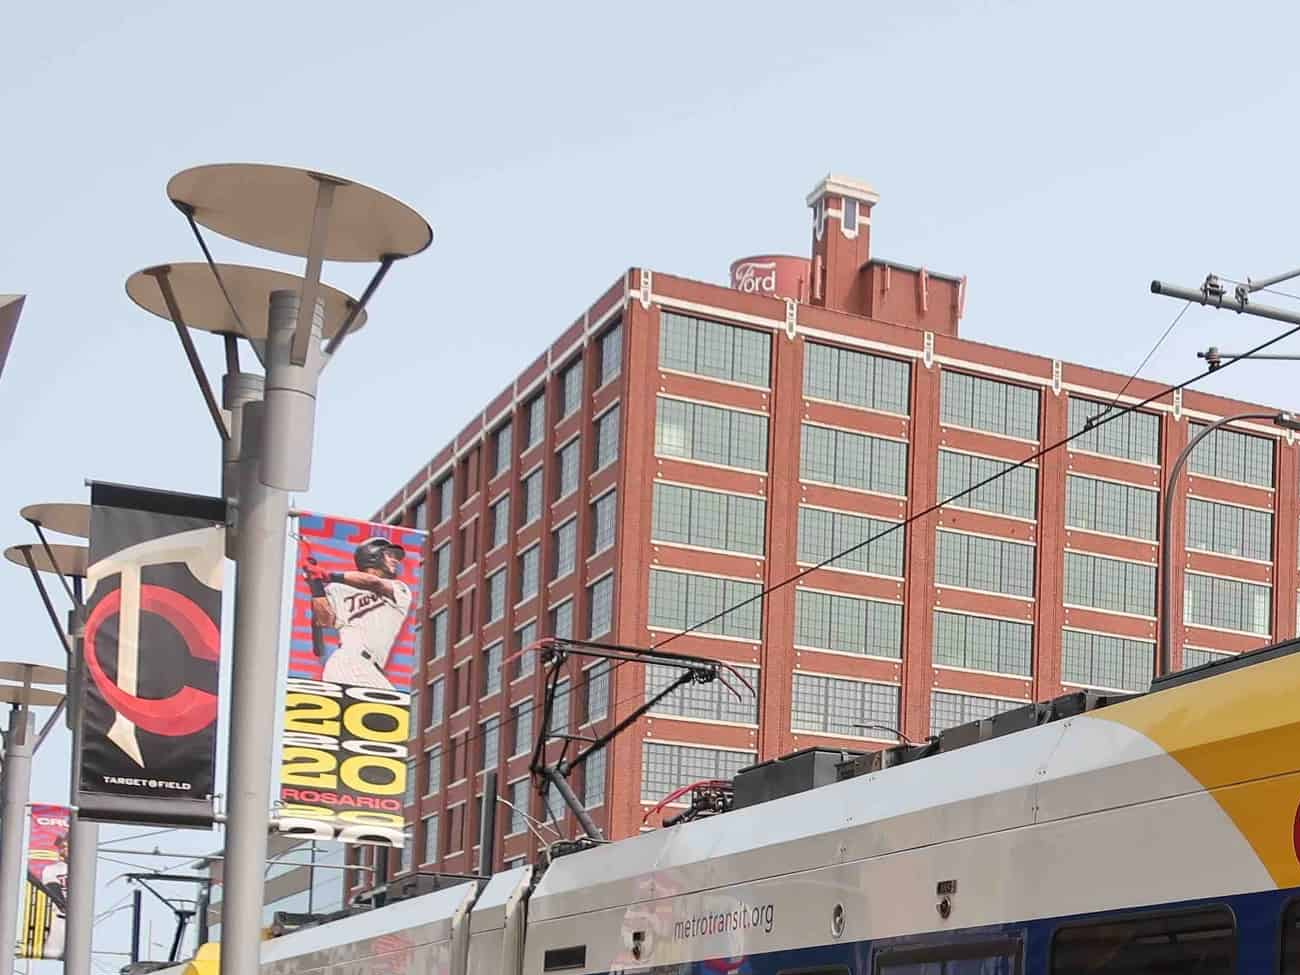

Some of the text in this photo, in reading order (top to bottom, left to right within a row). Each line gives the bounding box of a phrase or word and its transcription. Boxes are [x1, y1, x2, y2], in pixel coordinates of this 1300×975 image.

[735, 262, 777, 293] Ford
[284, 692, 410, 742] 20
[103, 775, 192, 790] TARGET FIELD
[281, 746, 407, 795] 20
[281, 787, 401, 811] ROSARIO
[673, 902, 775, 941] metrotransit.org
